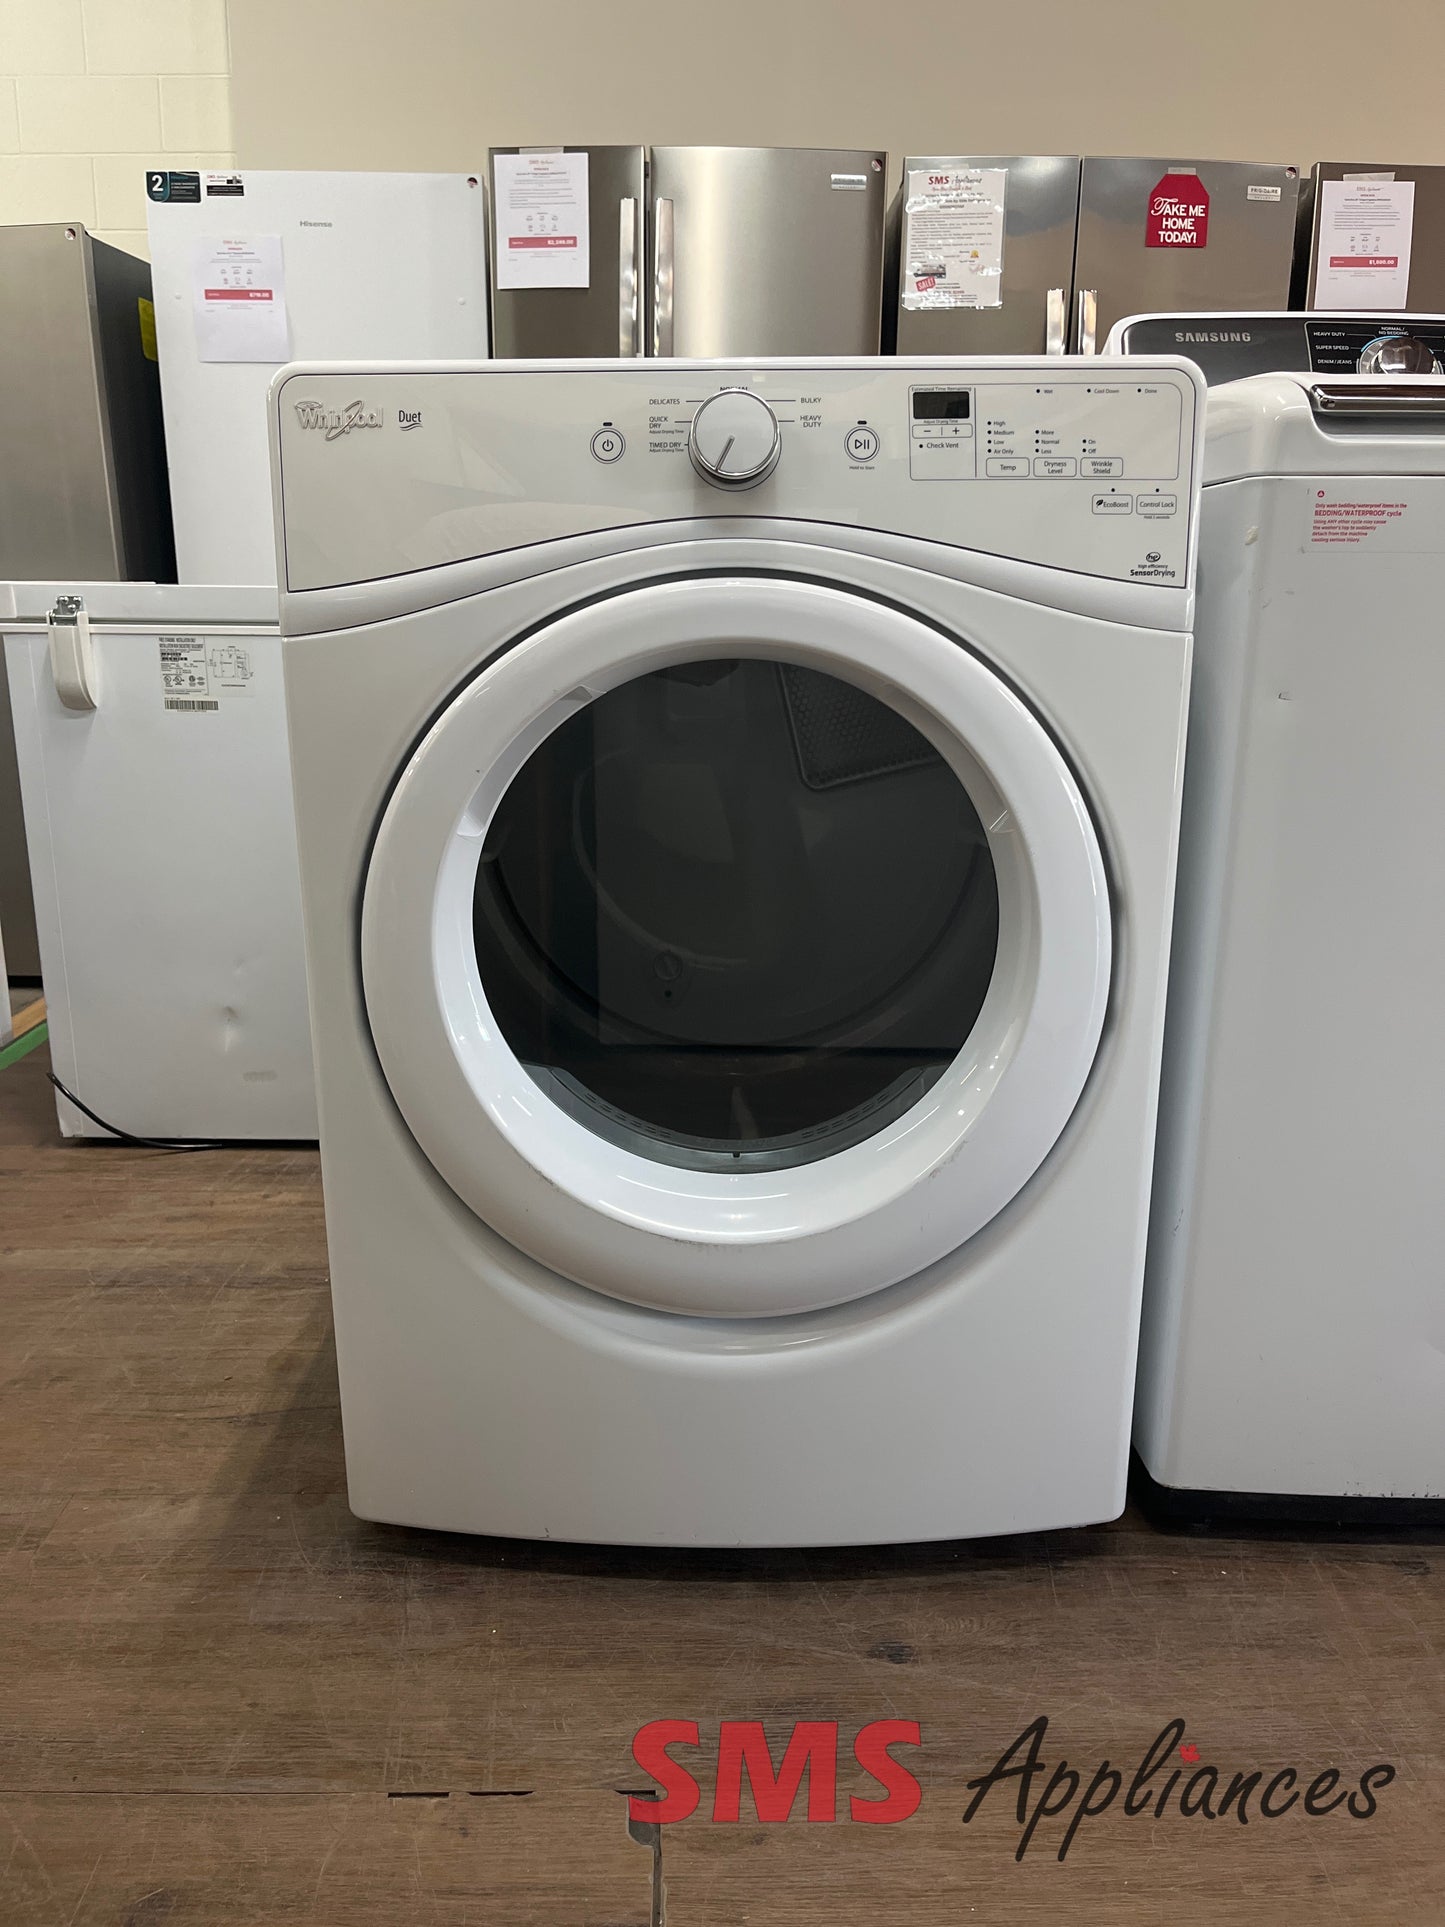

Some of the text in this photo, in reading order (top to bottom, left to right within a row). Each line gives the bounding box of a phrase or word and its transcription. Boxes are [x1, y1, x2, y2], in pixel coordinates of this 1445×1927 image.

[152, 174, 164, 192] 2
[929, 176, 950, 185] SMS
[1150, 197, 1206, 217] TAKE ME
[299, 220, 333, 228] Hisense
[1162, 217, 1195, 230] HOME
[1158, 230, 1197, 244] TODAY!
[1174, 332, 1251, 343] SAMSUNG
[295, 402, 384, 438] Whirlpool
[398, 409, 422, 423] Duet
[1000, 464, 1017, 473] Temp
[1091, 460, 1113, 468] Wrinkle
[1093, 467, 1111, 475] Shield
[1130, 569, 1176, 578] SensorDrying
